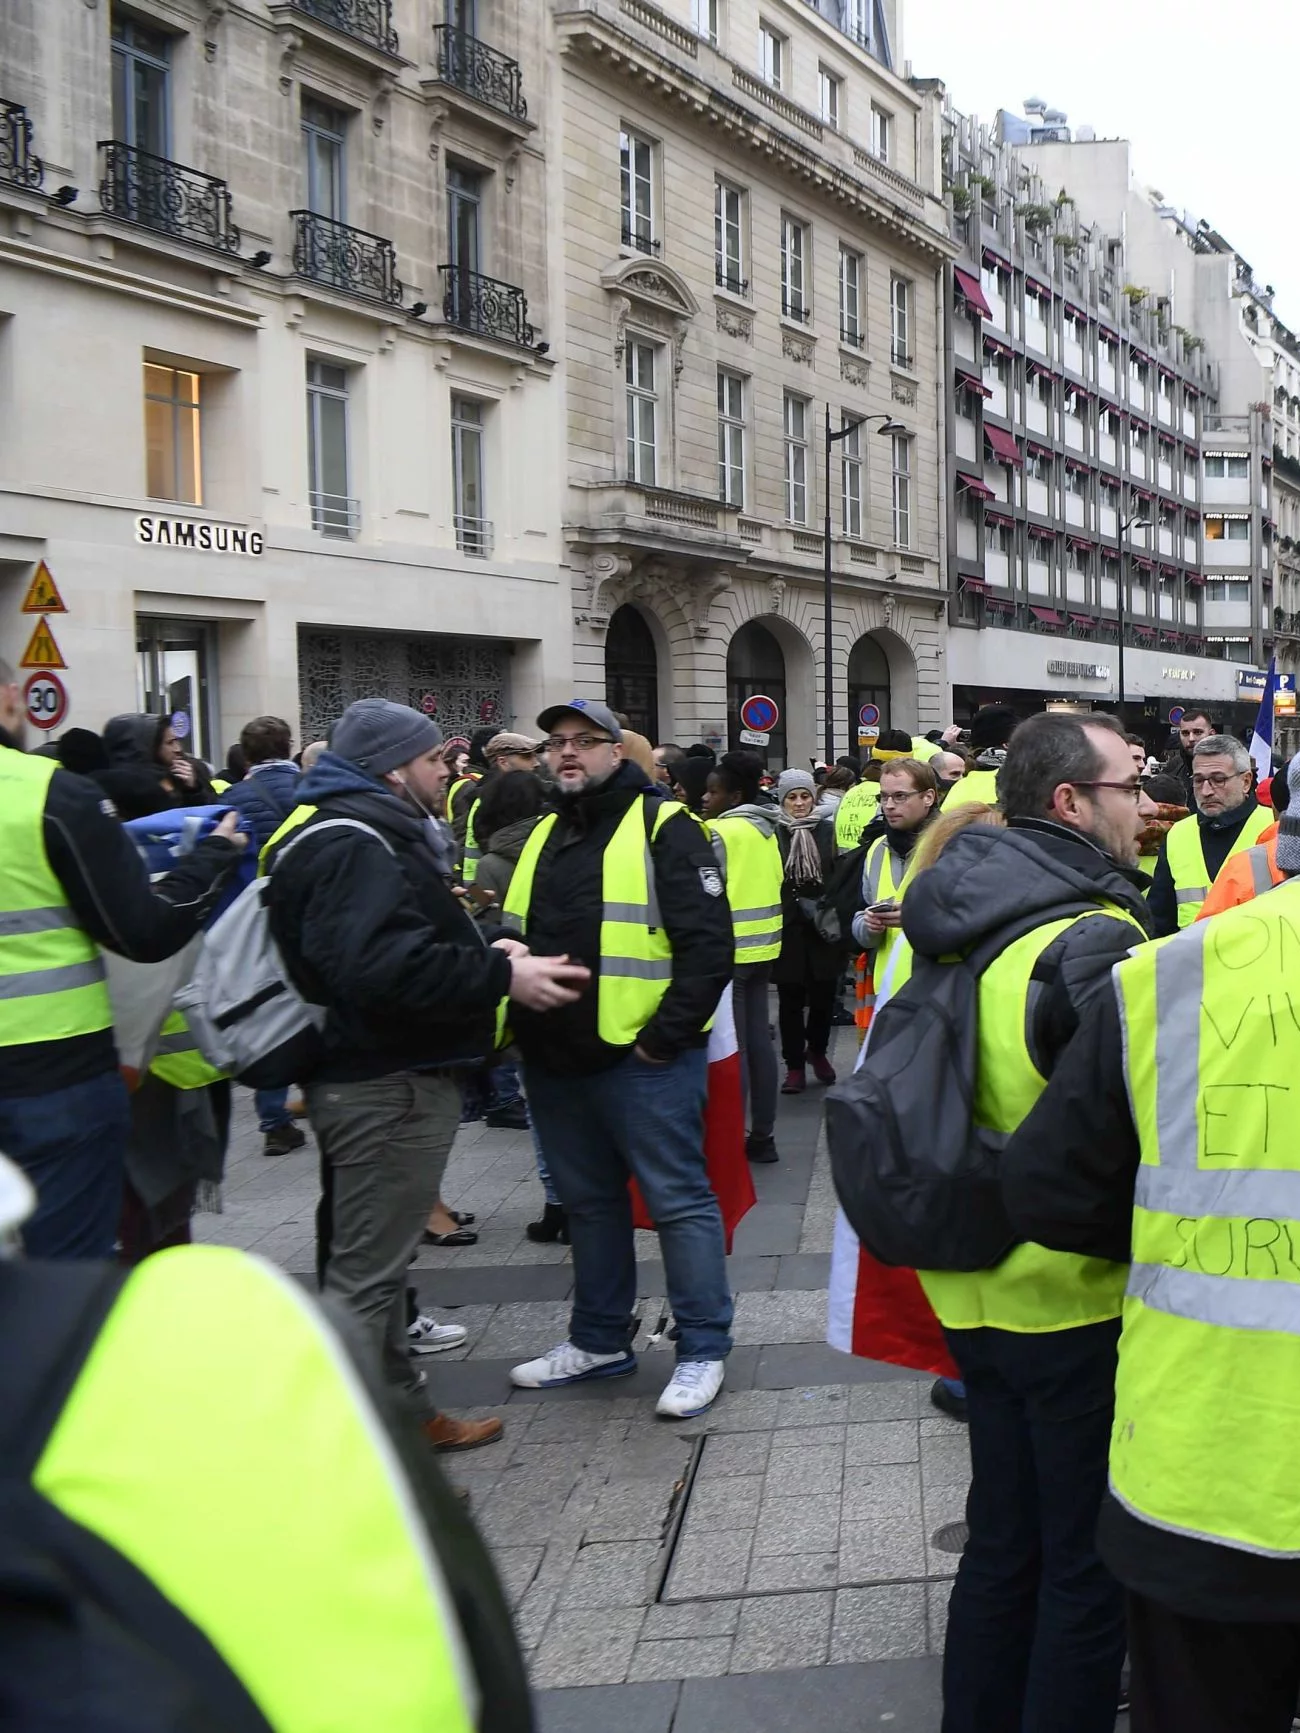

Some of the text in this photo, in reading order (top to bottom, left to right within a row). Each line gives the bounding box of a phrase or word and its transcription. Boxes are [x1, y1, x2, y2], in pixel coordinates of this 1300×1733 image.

[139, 517, 264, 555] SAMSUNG
[1279, 674, 1290, 689] P
[30, 687, 57, 713] 30
[1202, 1083, 1290, 1157] ET
